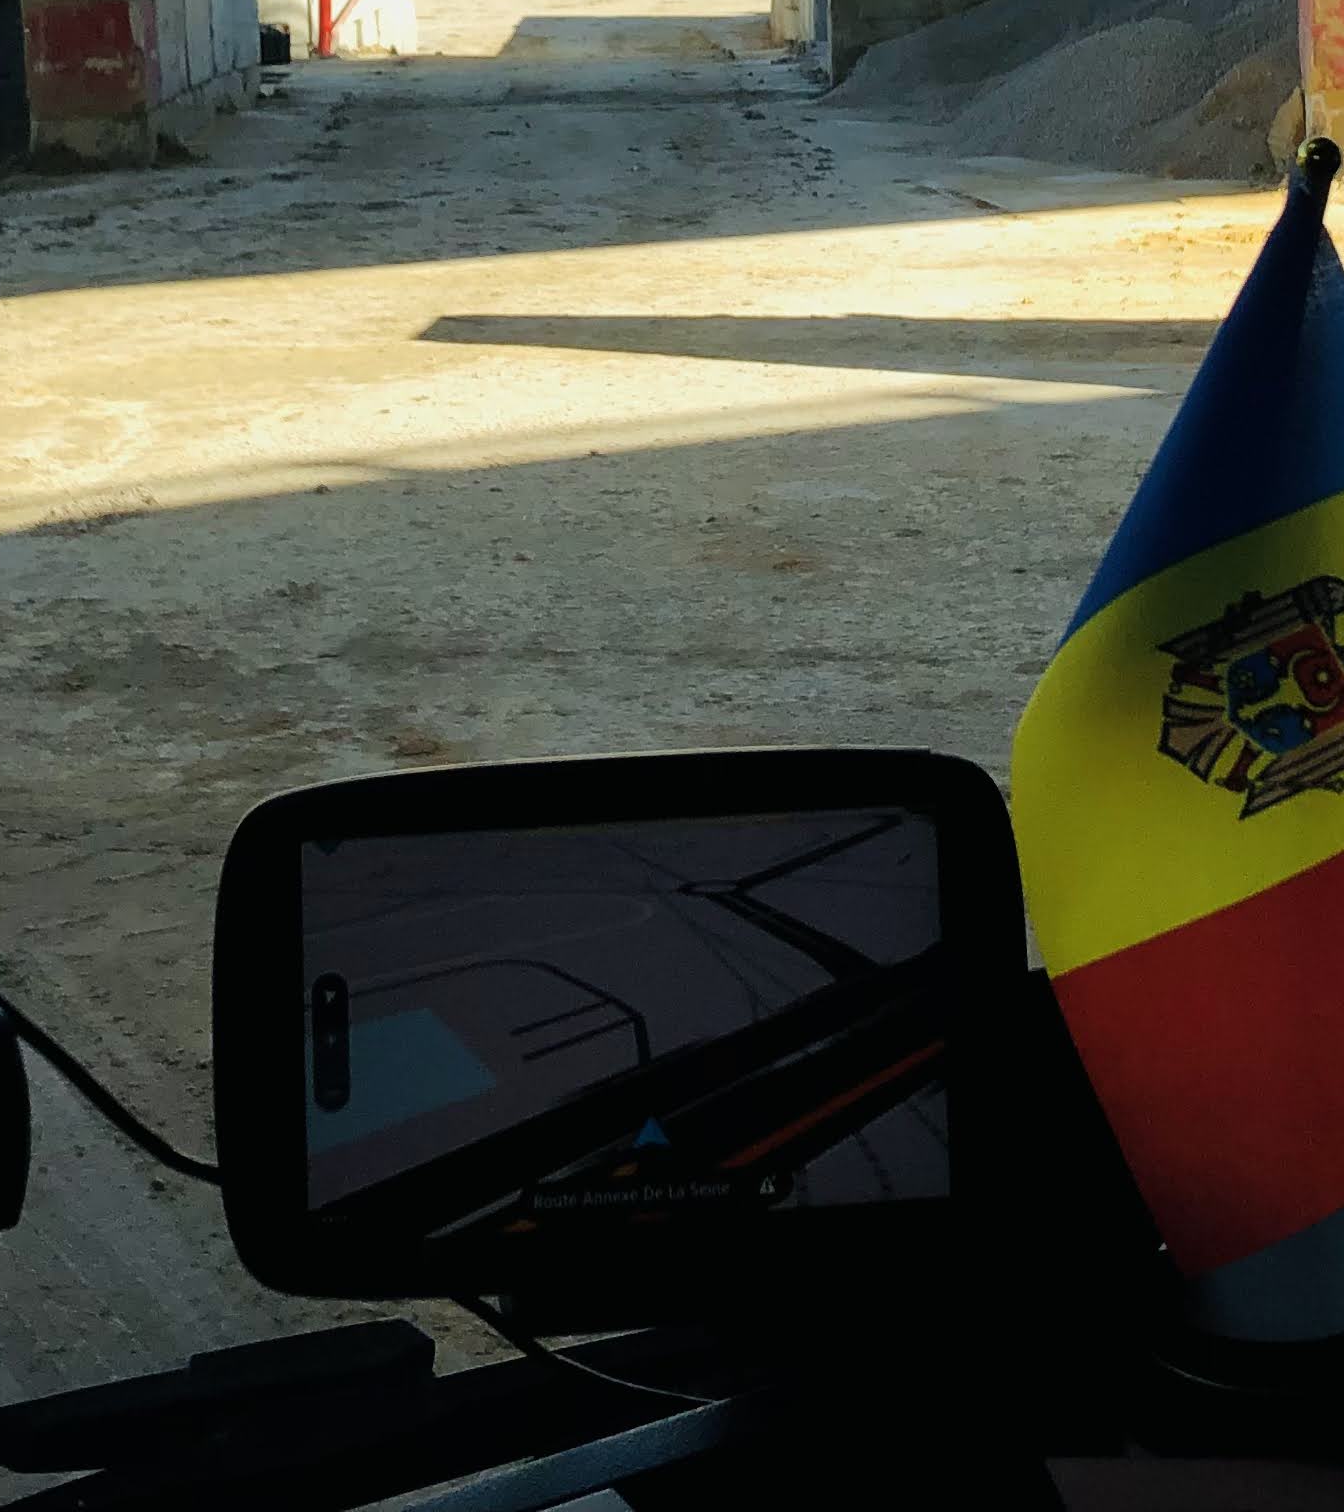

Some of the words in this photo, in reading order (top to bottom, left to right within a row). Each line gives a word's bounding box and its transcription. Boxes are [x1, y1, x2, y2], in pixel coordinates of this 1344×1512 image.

[533, 1191, 577, 1209] Route
[582, 1188, 640, 1208] Annexe
[643, 1184, 663, 1201] De
